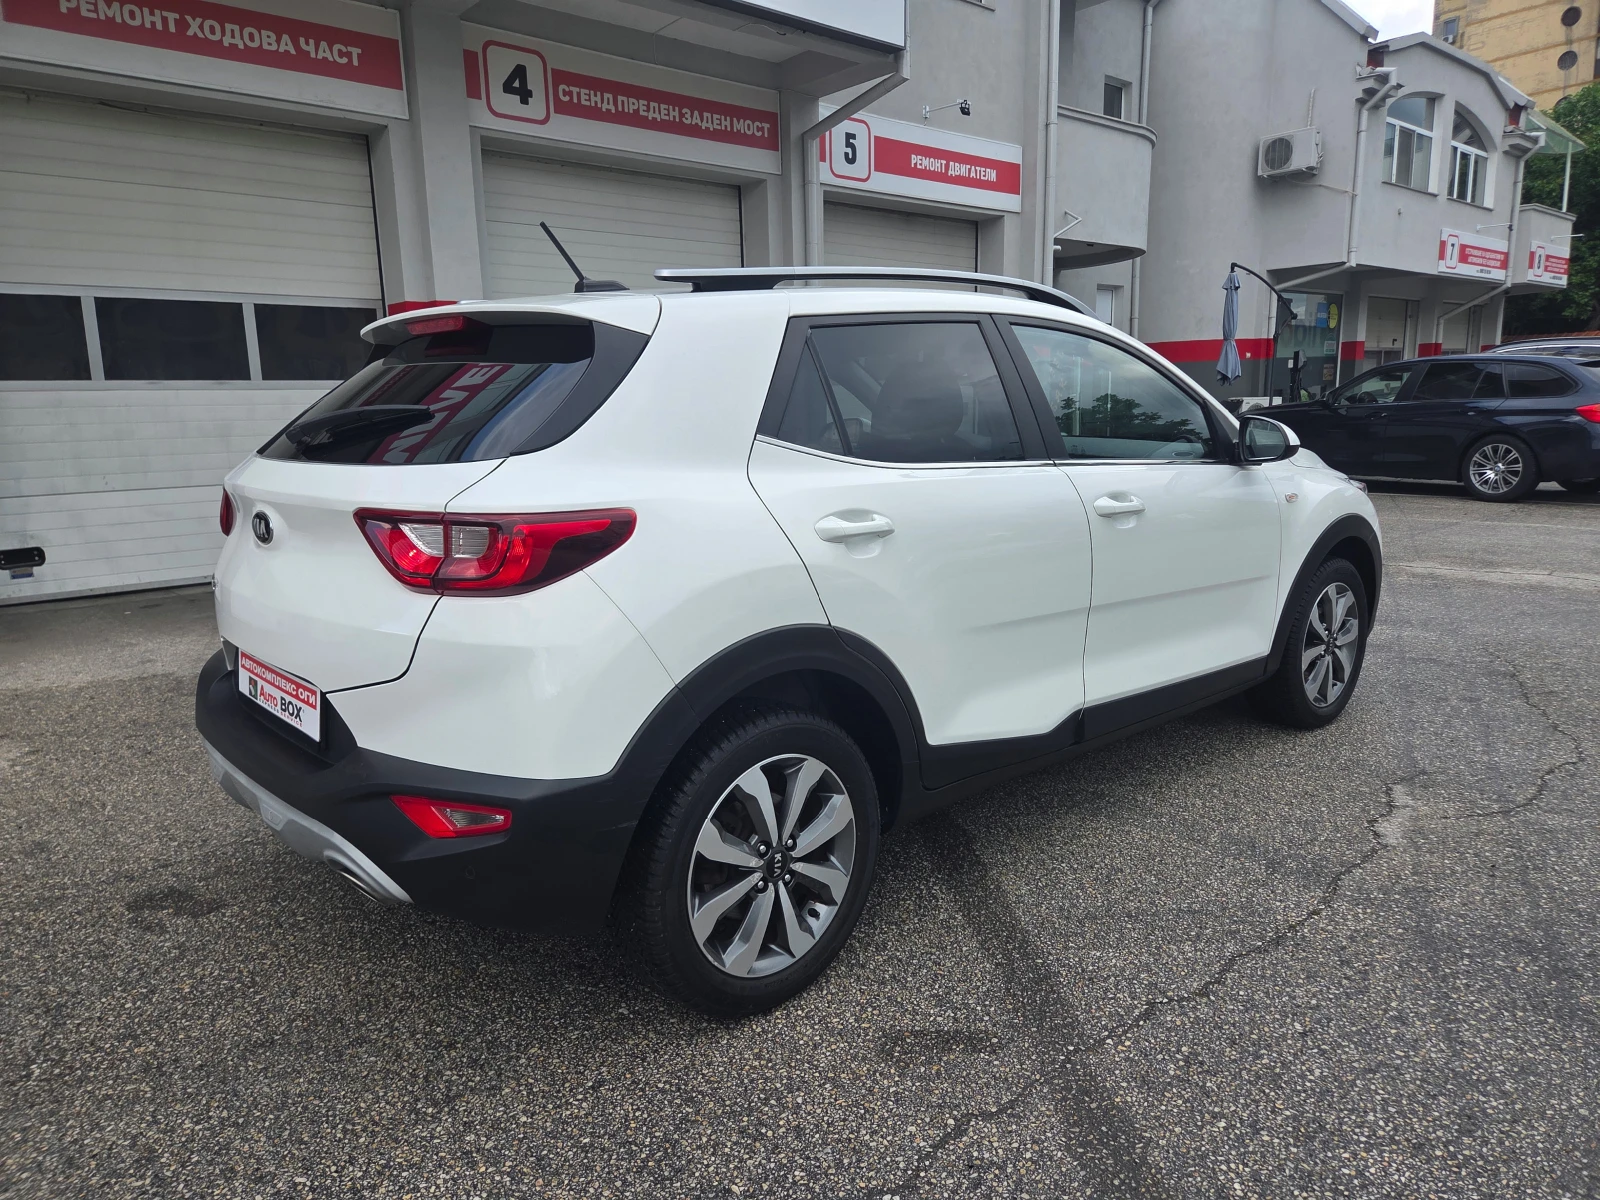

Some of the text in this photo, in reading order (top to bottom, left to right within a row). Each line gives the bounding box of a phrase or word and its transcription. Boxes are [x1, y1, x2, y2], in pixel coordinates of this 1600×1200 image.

[60, 0, 362, 67] РЕМОНТ ХОДОВА ЧАСТ
[502, 63, 534, 106] 4
[558, 84, 771, 138] СТЕНД ПРЕДЕН ЗАДЕН МОСТ
[843, 131, 857, 165] 5
[911, 154, 997, 182] РЕМОНТ ДВИГАТЕЛИ
[1450, 243, 1455, 261] 7
[241, 656, 317, 706] АВТОКОМПЛЕКС ОГИ
[280, 695, 303, 722] BOX
[280, 711, 303, 728] SERVICE
[774, 853, 782, 876] KIA
